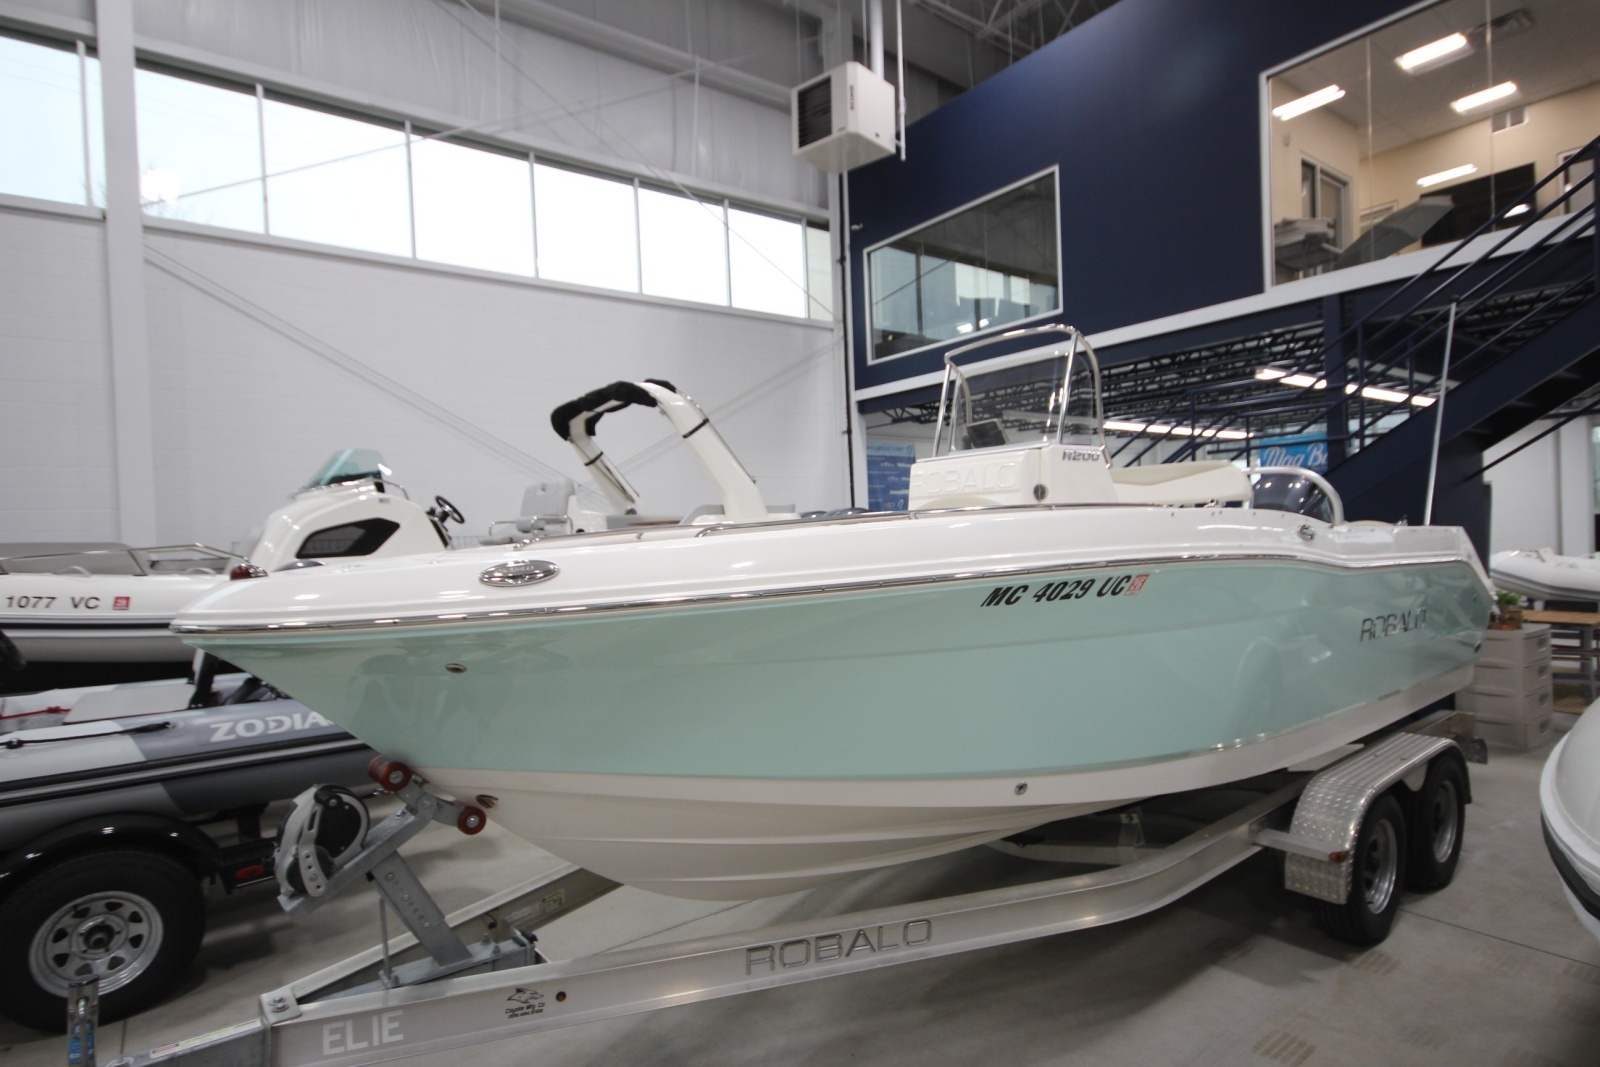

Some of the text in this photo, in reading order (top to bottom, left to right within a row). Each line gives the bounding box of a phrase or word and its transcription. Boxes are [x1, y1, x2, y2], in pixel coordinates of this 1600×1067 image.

[911, 464, 1018, 494] ROBALO
[6, 595, 100, 610] 1077 VC
[980, 574, 1132, 607] MC 4029 UC
[1360, 607, 1427, 642] ROBALO
[209, 711, 335, 742] ZODIA
[745, 919, 932, 976] ROBALO
[322, 1009, 404, 1056] ELIE
